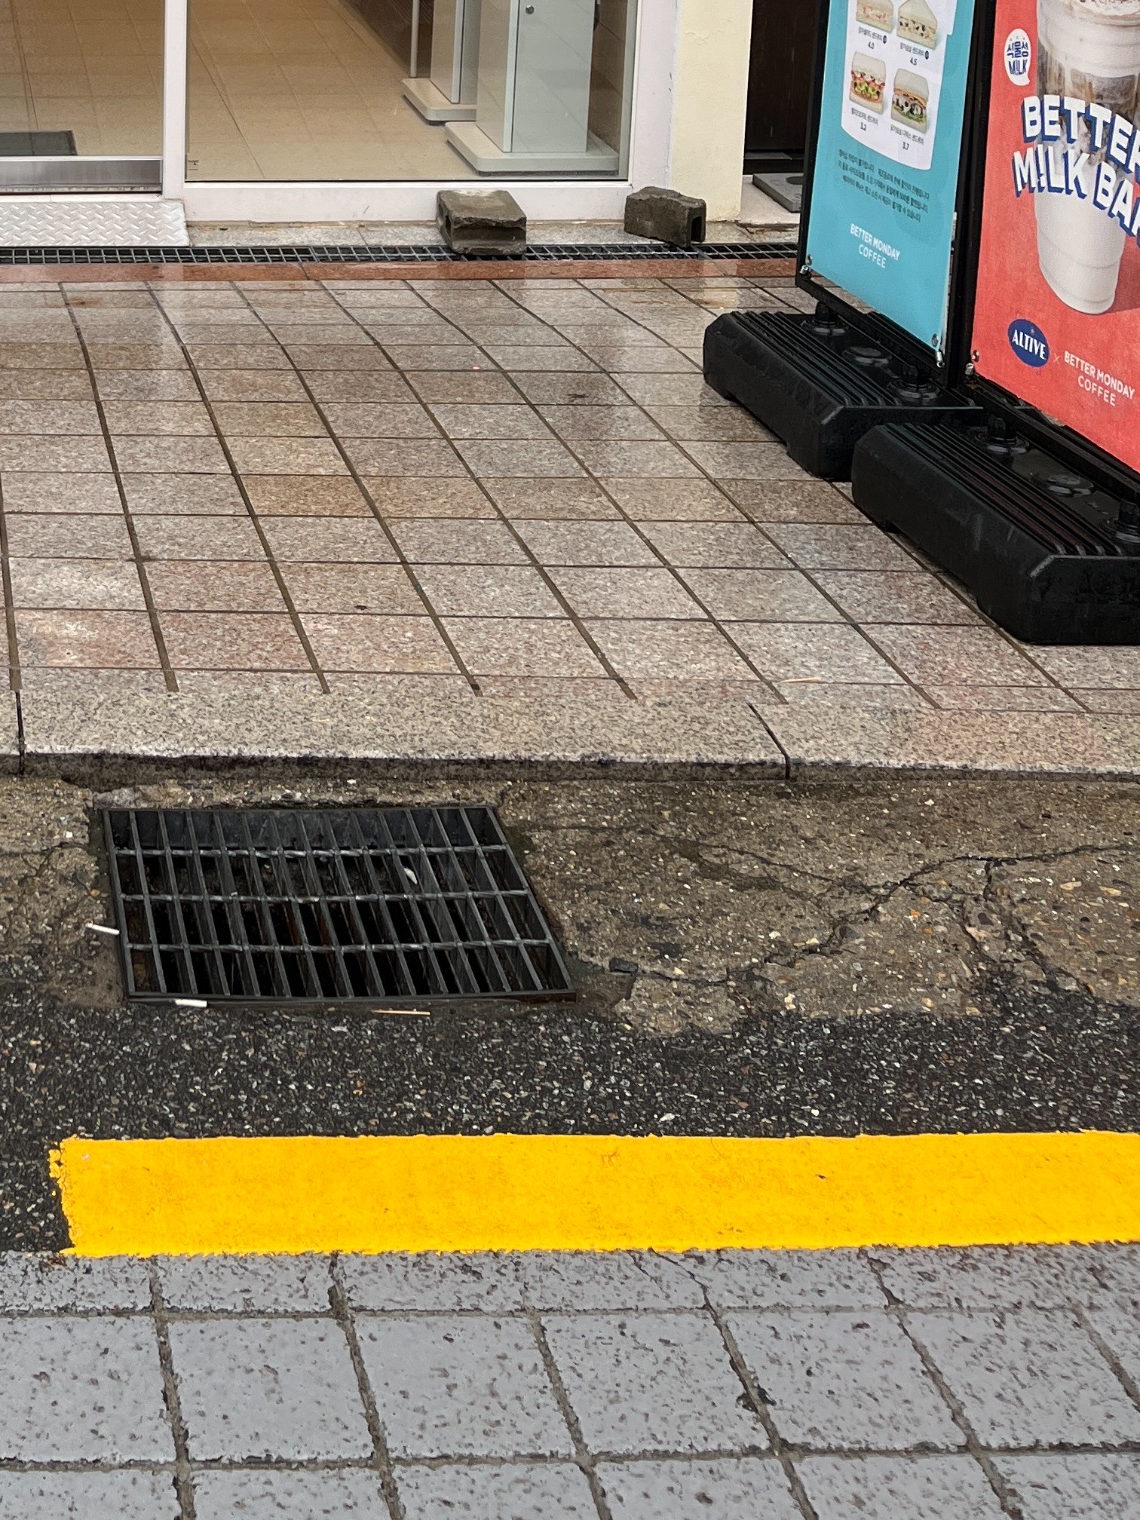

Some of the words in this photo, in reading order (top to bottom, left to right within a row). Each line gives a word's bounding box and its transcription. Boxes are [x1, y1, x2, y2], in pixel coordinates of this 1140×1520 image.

[1006, 41, 1029, 58] 식물성
[850, 223, 872, 246] BETTER
[872, 238, 901, 261] MONDAY
[858, 244, 887, 269] COFFEE
[1011, 325, 1047, 362] ALTIVE
[1063, 350, 1097, 379] BETTER
[1096, 366, 1136, 398] MONDAY
[1077, 375, 1116, 408] COFFEE
